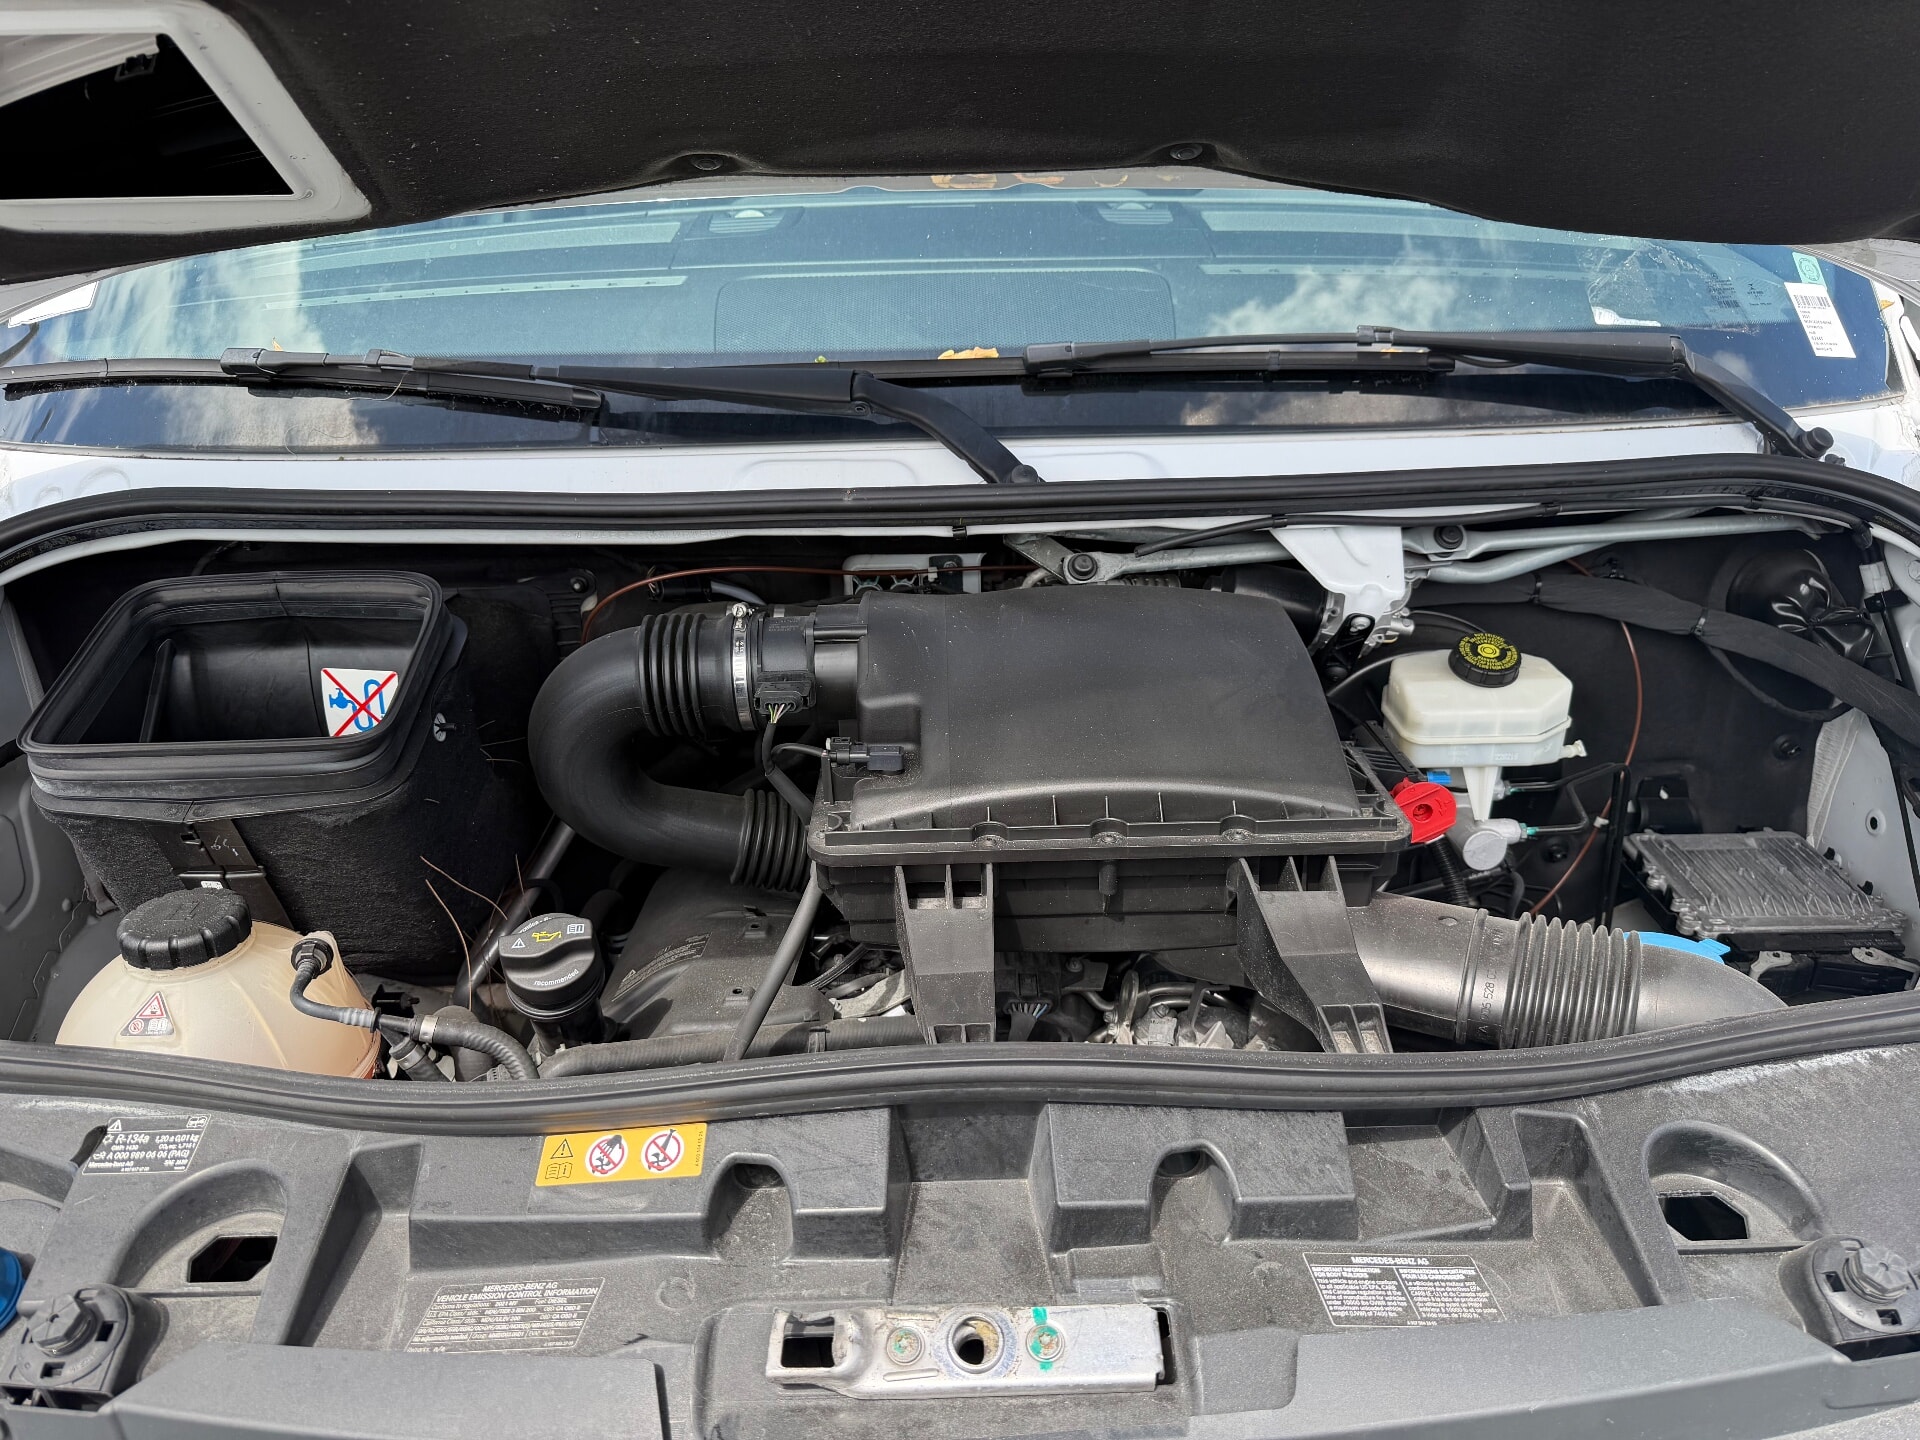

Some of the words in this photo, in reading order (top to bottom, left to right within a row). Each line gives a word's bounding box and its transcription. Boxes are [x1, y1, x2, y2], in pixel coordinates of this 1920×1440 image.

[533, 968, 579, 986] recommended
[1483, 981, 1495, 999] 528
[115, 1133, 150, 1145] R-134a
[106, 1151, 114, 1160] A
[114, 1151, 130, 1160] 000
[168, 1149, 190, 1160] (PAG)
[1351, 1256, 1416, 1265] MERCEDES-BENZ
[1417, 1257, 1430, 1265] AG
[482, 1283, 546, 1293] MERCEDES-BENZ
[545, 1281, 558, 1290] AG
[436, 1293, 469, 1303] VEHICLE
[468, 1291, 507, 1301] EMISSION
[507, 1290, 542, 1299] CONTROL
[543, 1287, 598, 1297] INFORMATION
